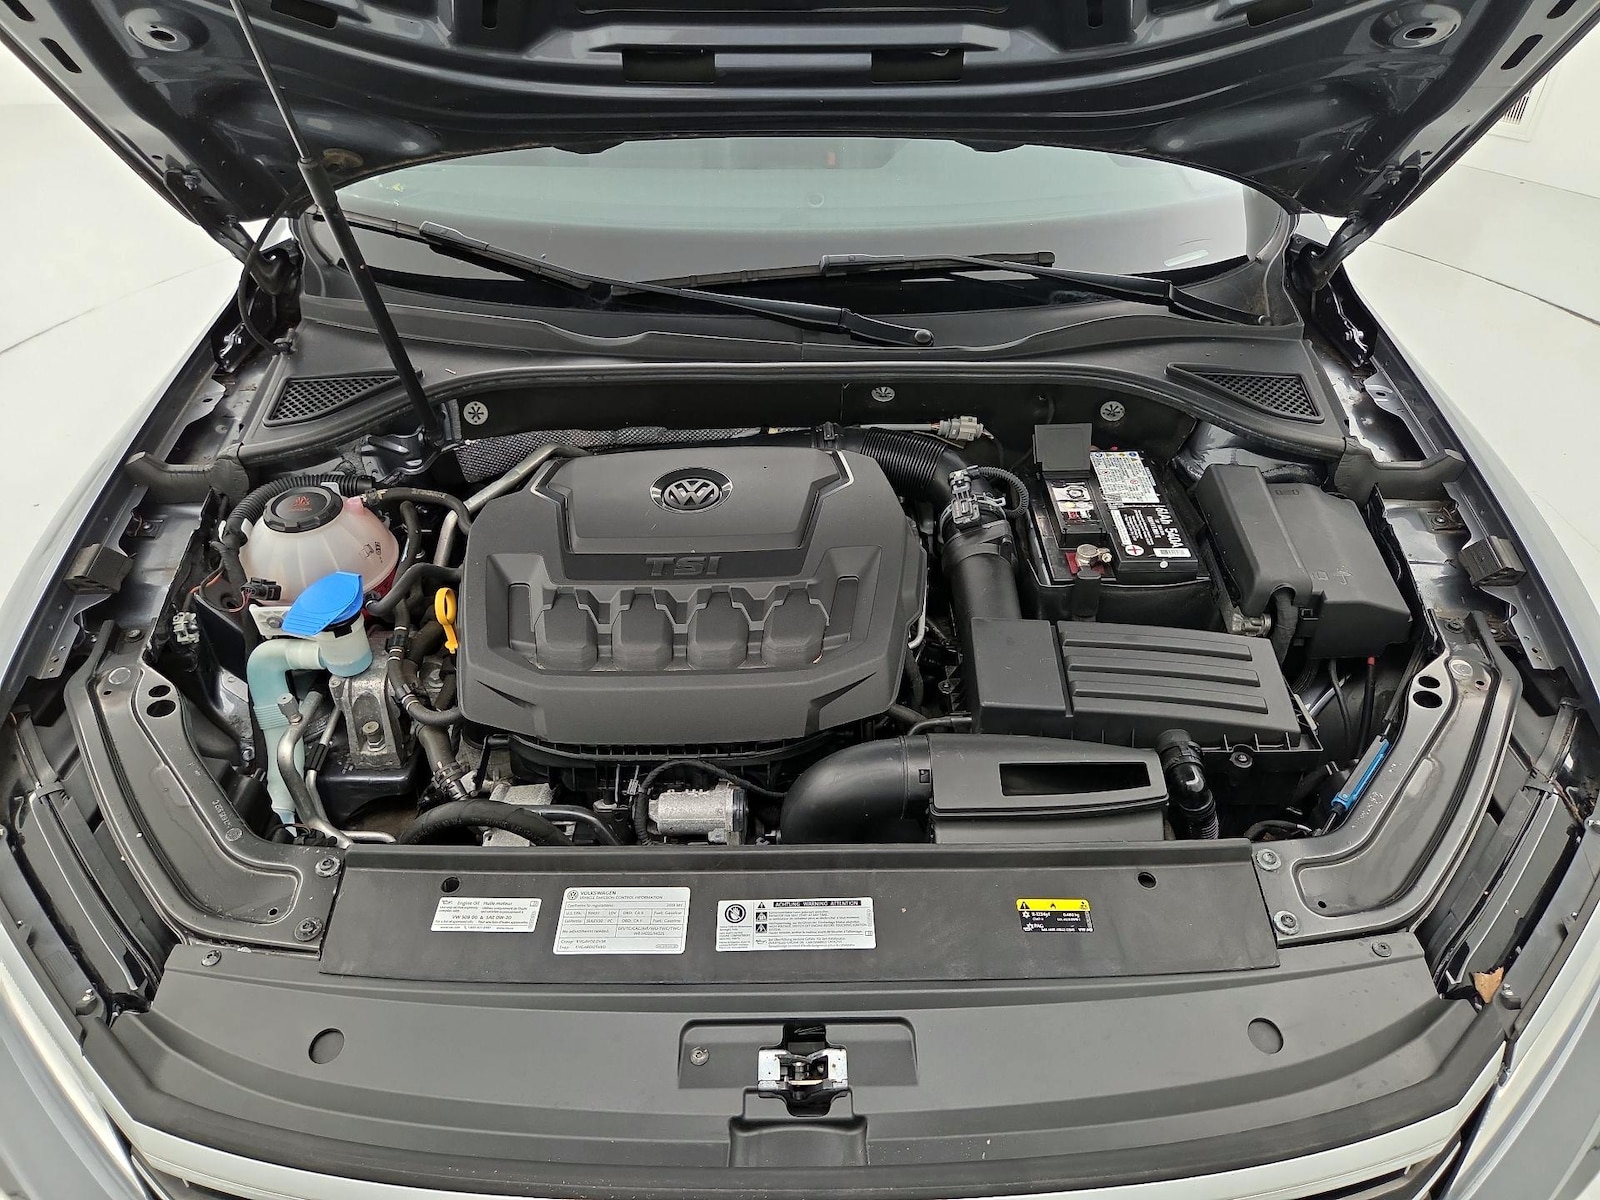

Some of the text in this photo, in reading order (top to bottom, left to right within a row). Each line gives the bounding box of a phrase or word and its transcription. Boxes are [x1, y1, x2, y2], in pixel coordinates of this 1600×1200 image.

[1155, 507, 1173, 525] 61Ah
[1164, 527, 1184, 548] 540A
[645, 556, 722, 577] TSI
